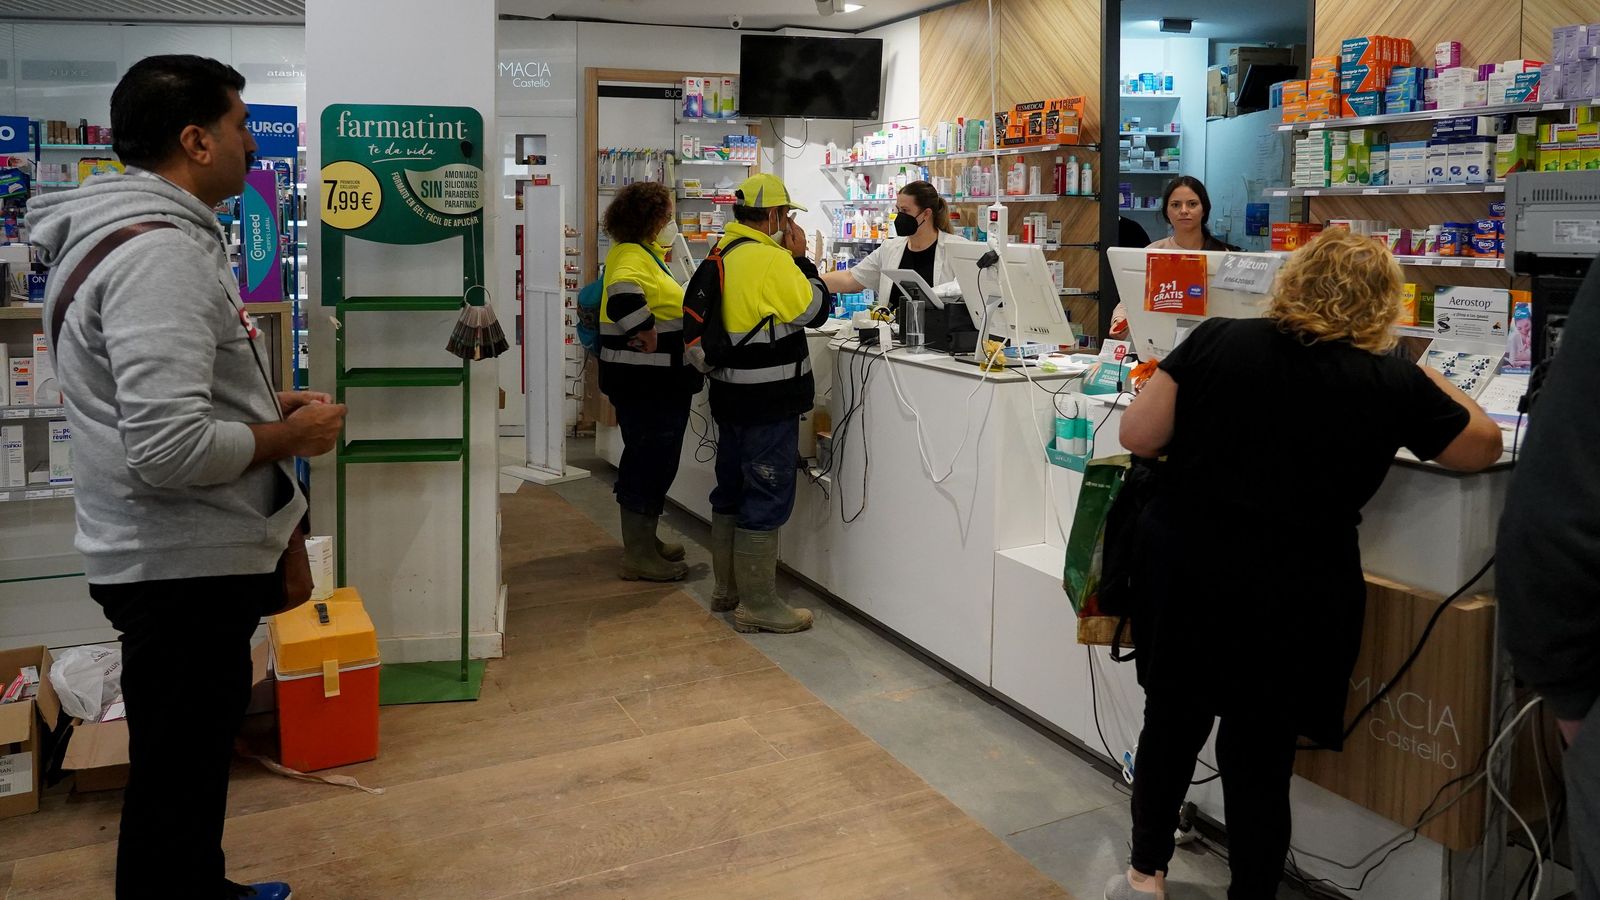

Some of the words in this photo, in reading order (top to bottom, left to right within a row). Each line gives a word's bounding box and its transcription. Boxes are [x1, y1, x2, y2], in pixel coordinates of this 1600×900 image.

[252, 122, 295, 133] URGO
[338, 110, 467, 140] farmatint
[368, 144, 380, 156] te
[385, 142, 402, 156] da
[406, 143, 437, 156] vida
[444, 170, 478, 180] AMONIACO
[421, 180, 442, 198] SIN
[444, 180, 478, 189] SILICONAS
[444, 191, 480, 199] PARABENES
[444, 200, 477, 208] PARAFINAS
[443, 219, 452, 227] DE
[249, 214, 266, 261] Compeed
[1237, 258, 1268, 270] bizum
[1160, 280, 1177, 293] 2+1
[1153, 291, 1184, 302] GRATIS
[1449, 296, 1491, 310] Aerostop
